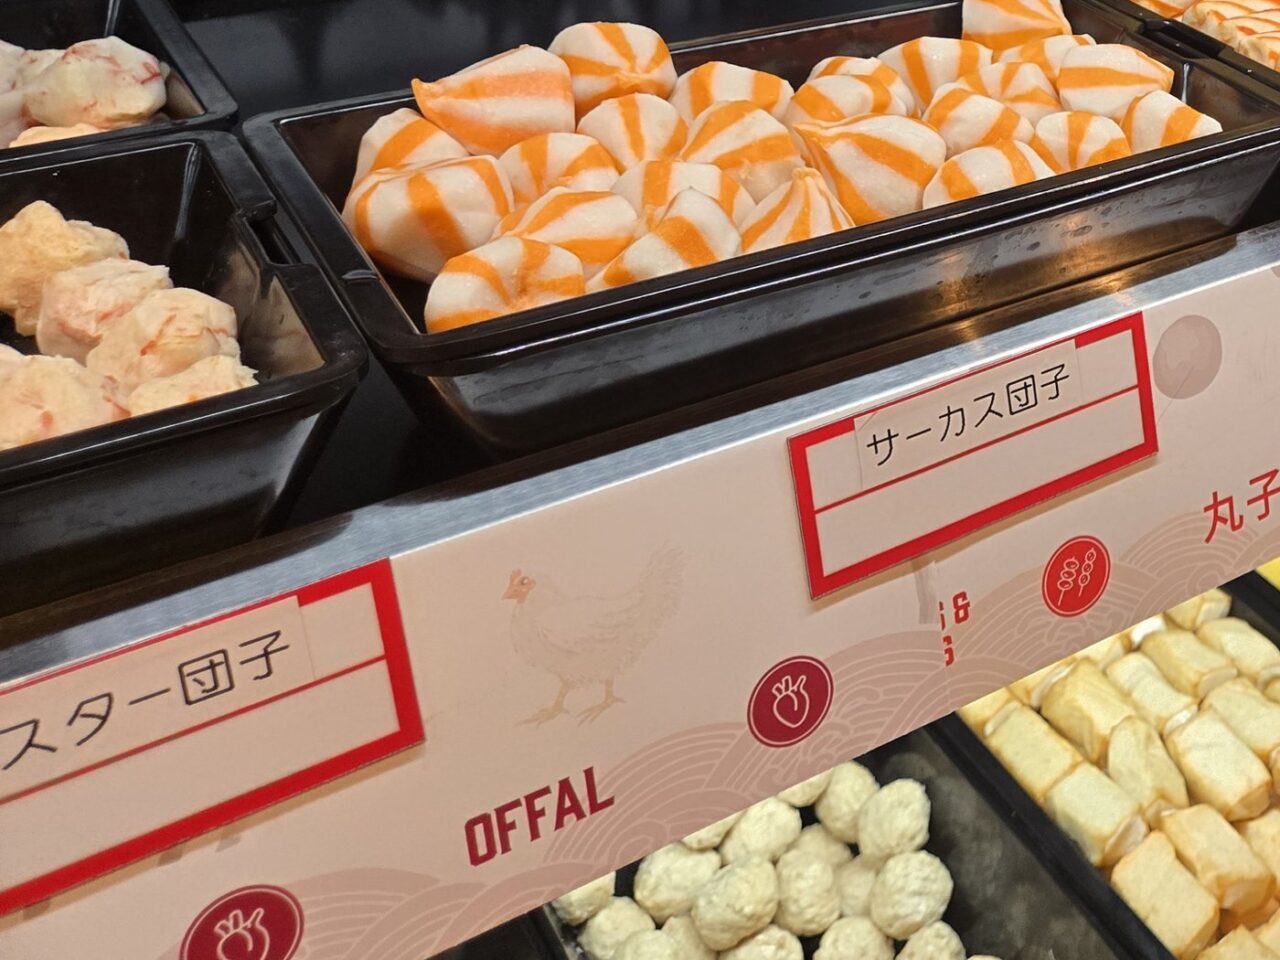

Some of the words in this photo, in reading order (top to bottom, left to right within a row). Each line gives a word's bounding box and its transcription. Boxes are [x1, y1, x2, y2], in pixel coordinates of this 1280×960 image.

[866, 362, 1071, 467] サーカス団子
[0, 630, 290, 770] スター団子
[463, 766, 615, 866] OFFAL
